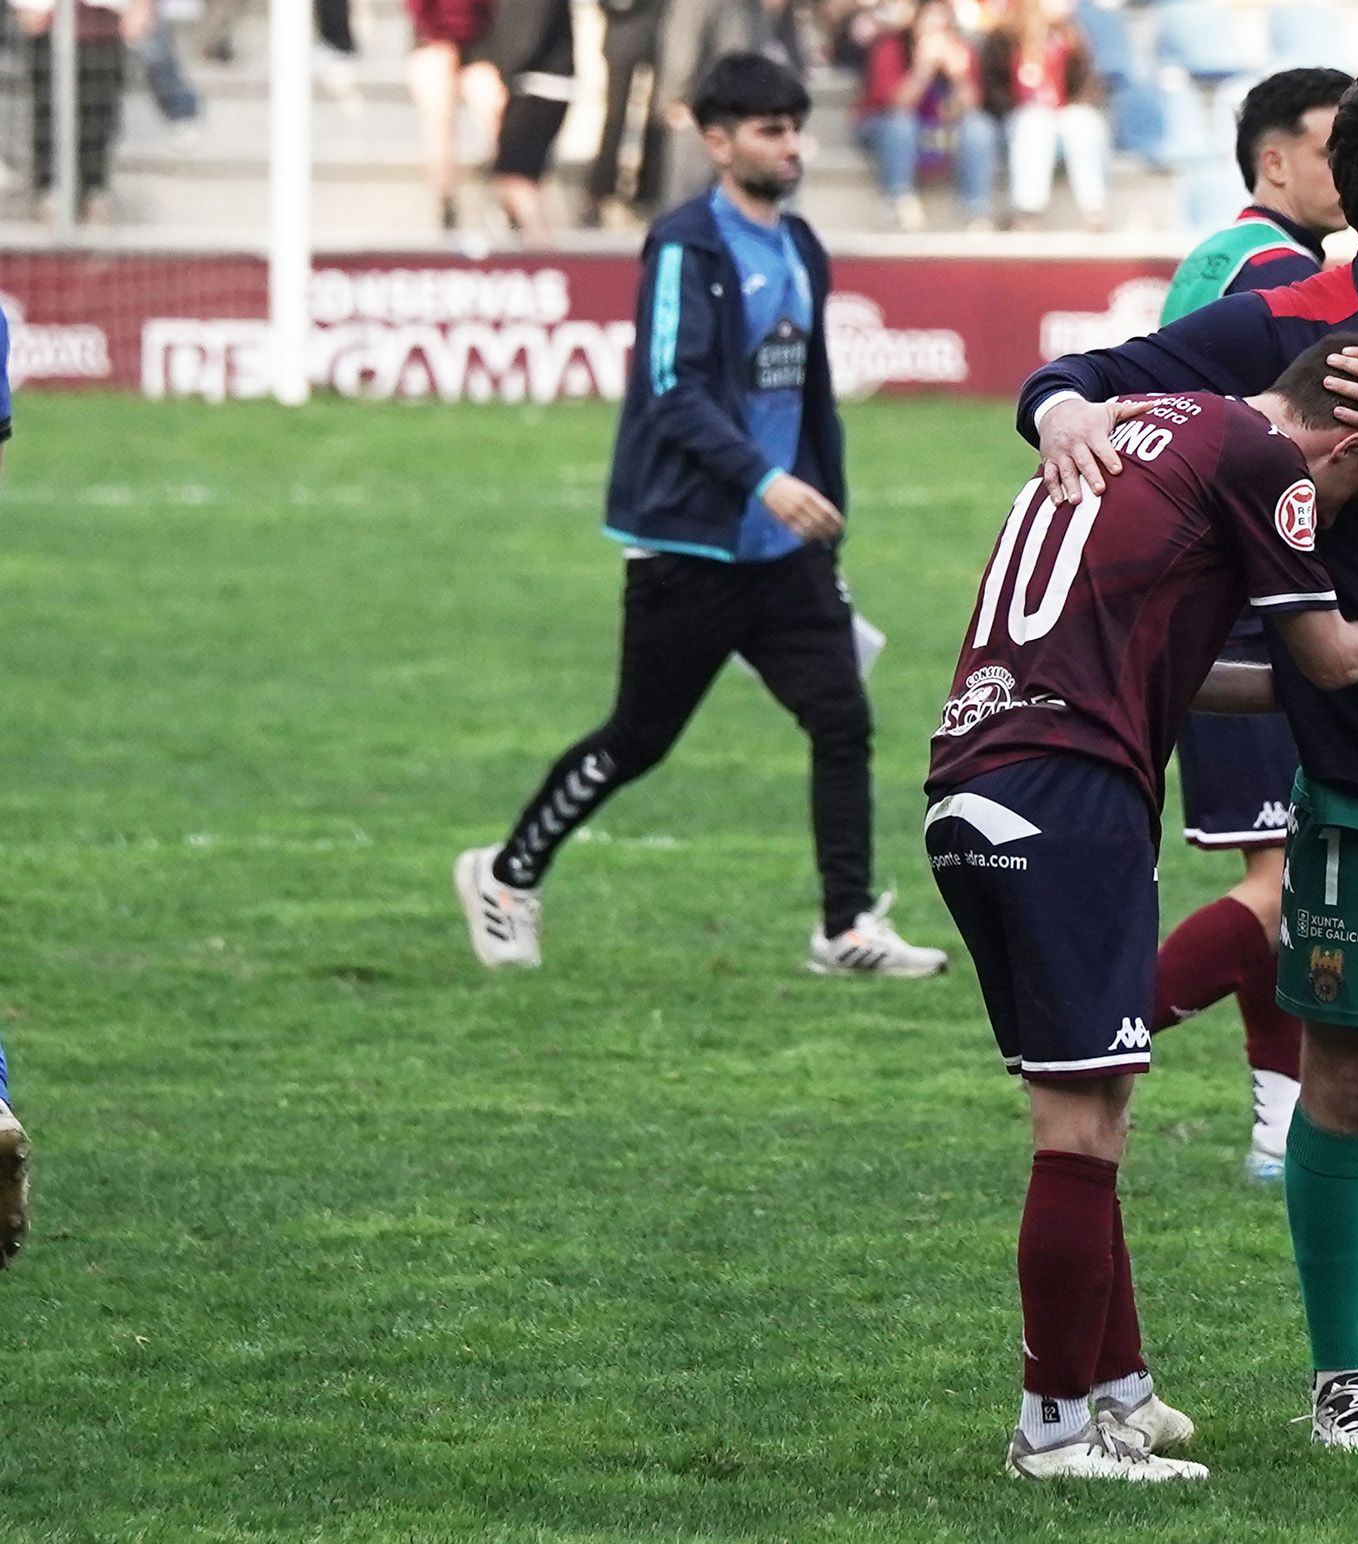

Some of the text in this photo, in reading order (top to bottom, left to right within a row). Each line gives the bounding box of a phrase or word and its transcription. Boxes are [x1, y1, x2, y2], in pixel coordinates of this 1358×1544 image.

[306, 268, 571, 325] ONSERVAS
[1147, 406, 1189, 425] dra
[1108, 420, 1174, 462] INO
[971, 473, 1103, 649] 10
[1318, 827, 1342, 906] 1
[1310, 926, 1324, 938] DE
[1311, 914, 1346, 930] XUNTA
